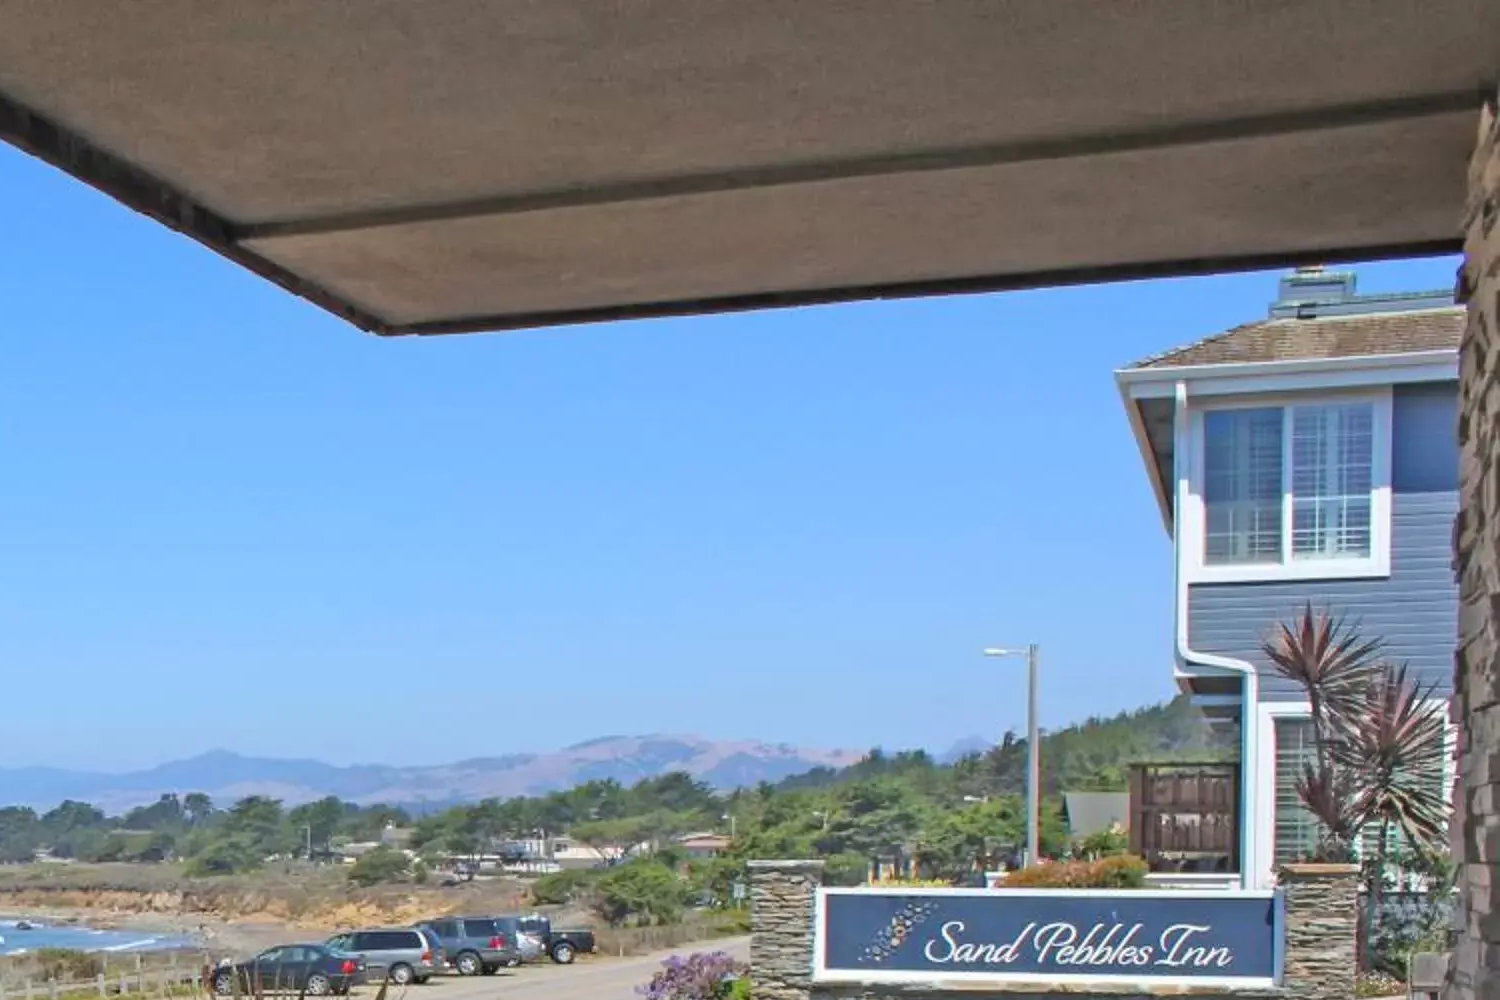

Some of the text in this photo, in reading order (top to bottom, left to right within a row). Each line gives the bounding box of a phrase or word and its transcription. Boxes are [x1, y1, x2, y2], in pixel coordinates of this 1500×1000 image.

[925, 921, 1235, 968] Sand Pebbles Inn
